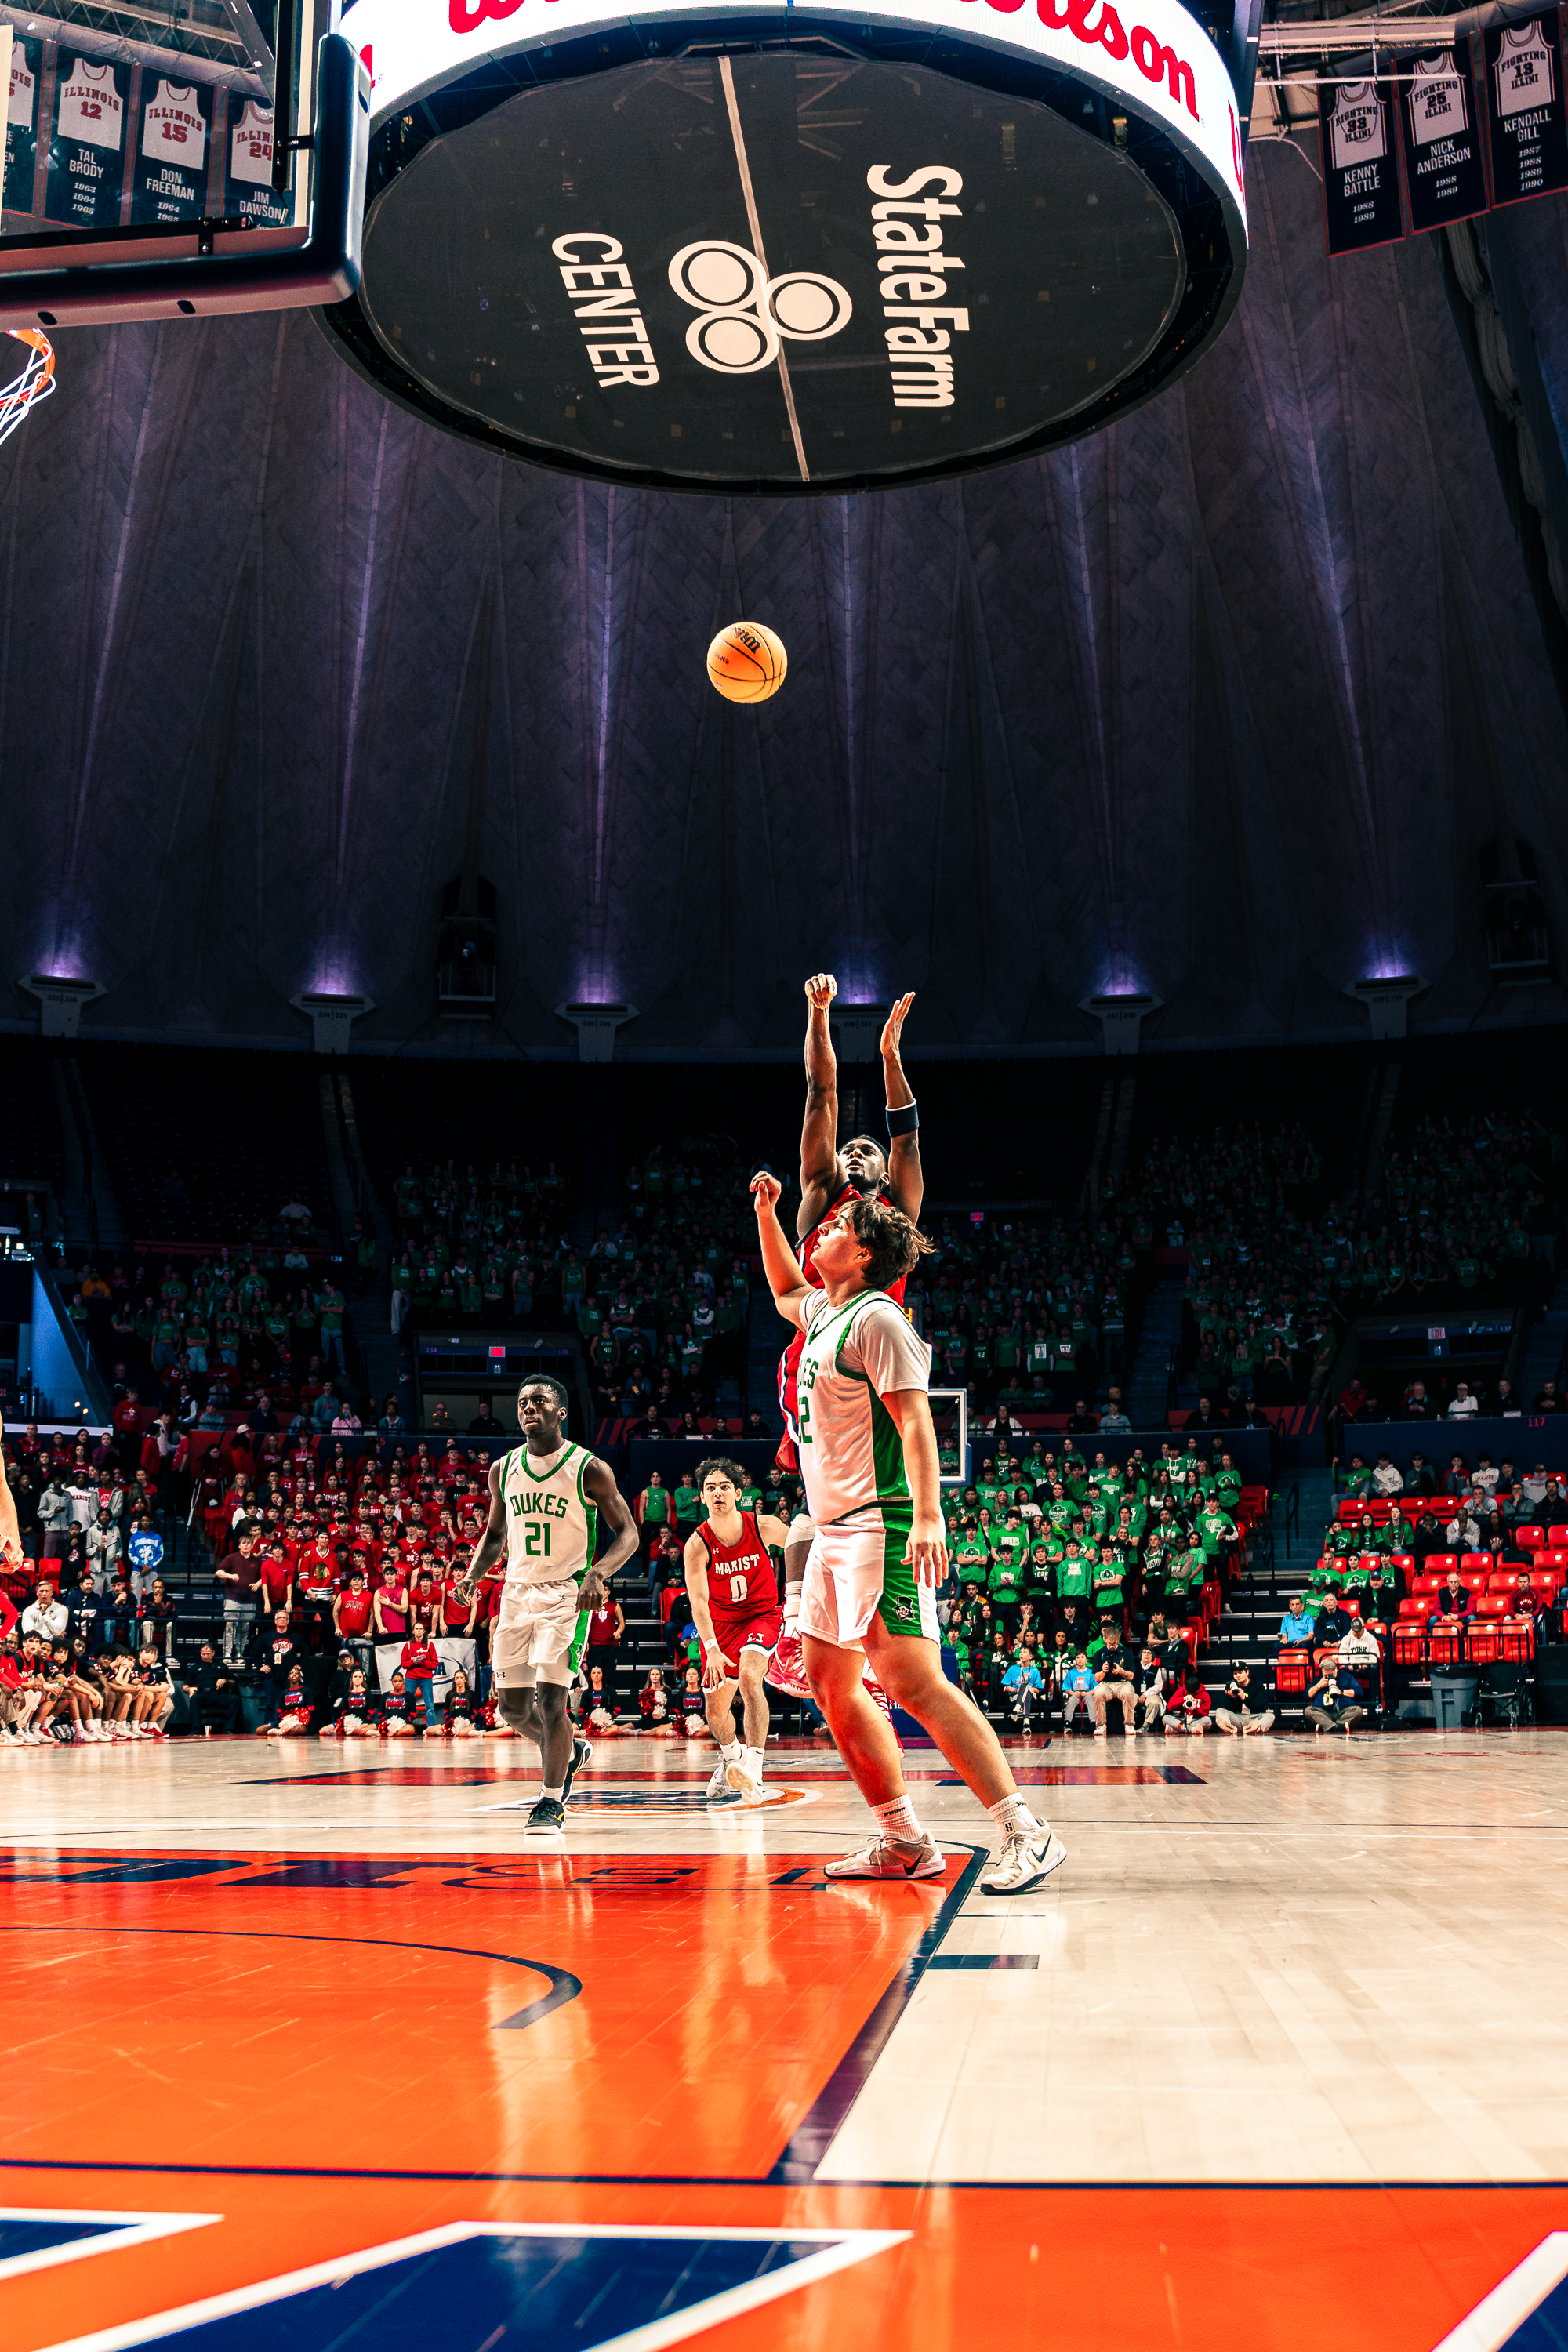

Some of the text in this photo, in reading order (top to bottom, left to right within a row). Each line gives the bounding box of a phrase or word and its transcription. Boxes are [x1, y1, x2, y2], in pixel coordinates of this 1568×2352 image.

[1501, 50, 1546, 73] FIGHTING
[1514, 61, 1534, 78] 13
[1511, 74, 1539, 90] ILLINI
[64, 87, 119, 111] ILLINOIS
[1414, 80, 1458, 103] FIGHTING
[1426, 91, 1447, 108] 25
[80, 100, 103, 121] 12
[1425, 103, 1452, 119] ILLINI
[148, 107, 203, 132] ILLINOIS
[1504, 109, 1552, 133] KENDALL
[162, 122, 187, 143] 15
[1345, 128, 1372, 143] ILLINI
[1517, 126, 1541, 143] GILL
[78, 148, 97, 165] TAL
[1430, 139, 1455, 158] NICK
[1519, 146, 1541, 158] 1987
[69, 159, 104, 179] BRODY
[1417, 147, 1471, 175] ANDERSON
[1519, 157, 1541, 169] 1988
[161, 169, 183, 185] DON
[1344, 164, 1377, 184] KENNY
[1435, 176, 1457, 187] 1988
[1519, 168, 1542, 180] 1989
[74, 182, 96, 194] 1963
[146, 178, 194, 201] FREEMAN
[1344, 176, 1381, 197] BATTLE
[1436, 186, 1458, 198] 1989
[1519, 179, 1543, 191] 1990
[72, 192, 96, 205] 1964
[252, 191, 270, 205] JIM
[158, 201, 180, 213] 1964
[239, 200, 282, 220] DAWSON
[1352, 201, 1374, 213] 1988
[1353, 212, 1375, 223] 1989
[551, 232, 661, 388] CENTER
[1431, 1329, 1442, 1338] EXIT
[1528, 1417, 1545, 1427] 117
[510, 1492, 569, 1519] DUKES
[524, 1522, 551, 1556] 21
[715, 1553, 760, 1575] MARIST
[729, 1574, 748, 1603] 0
